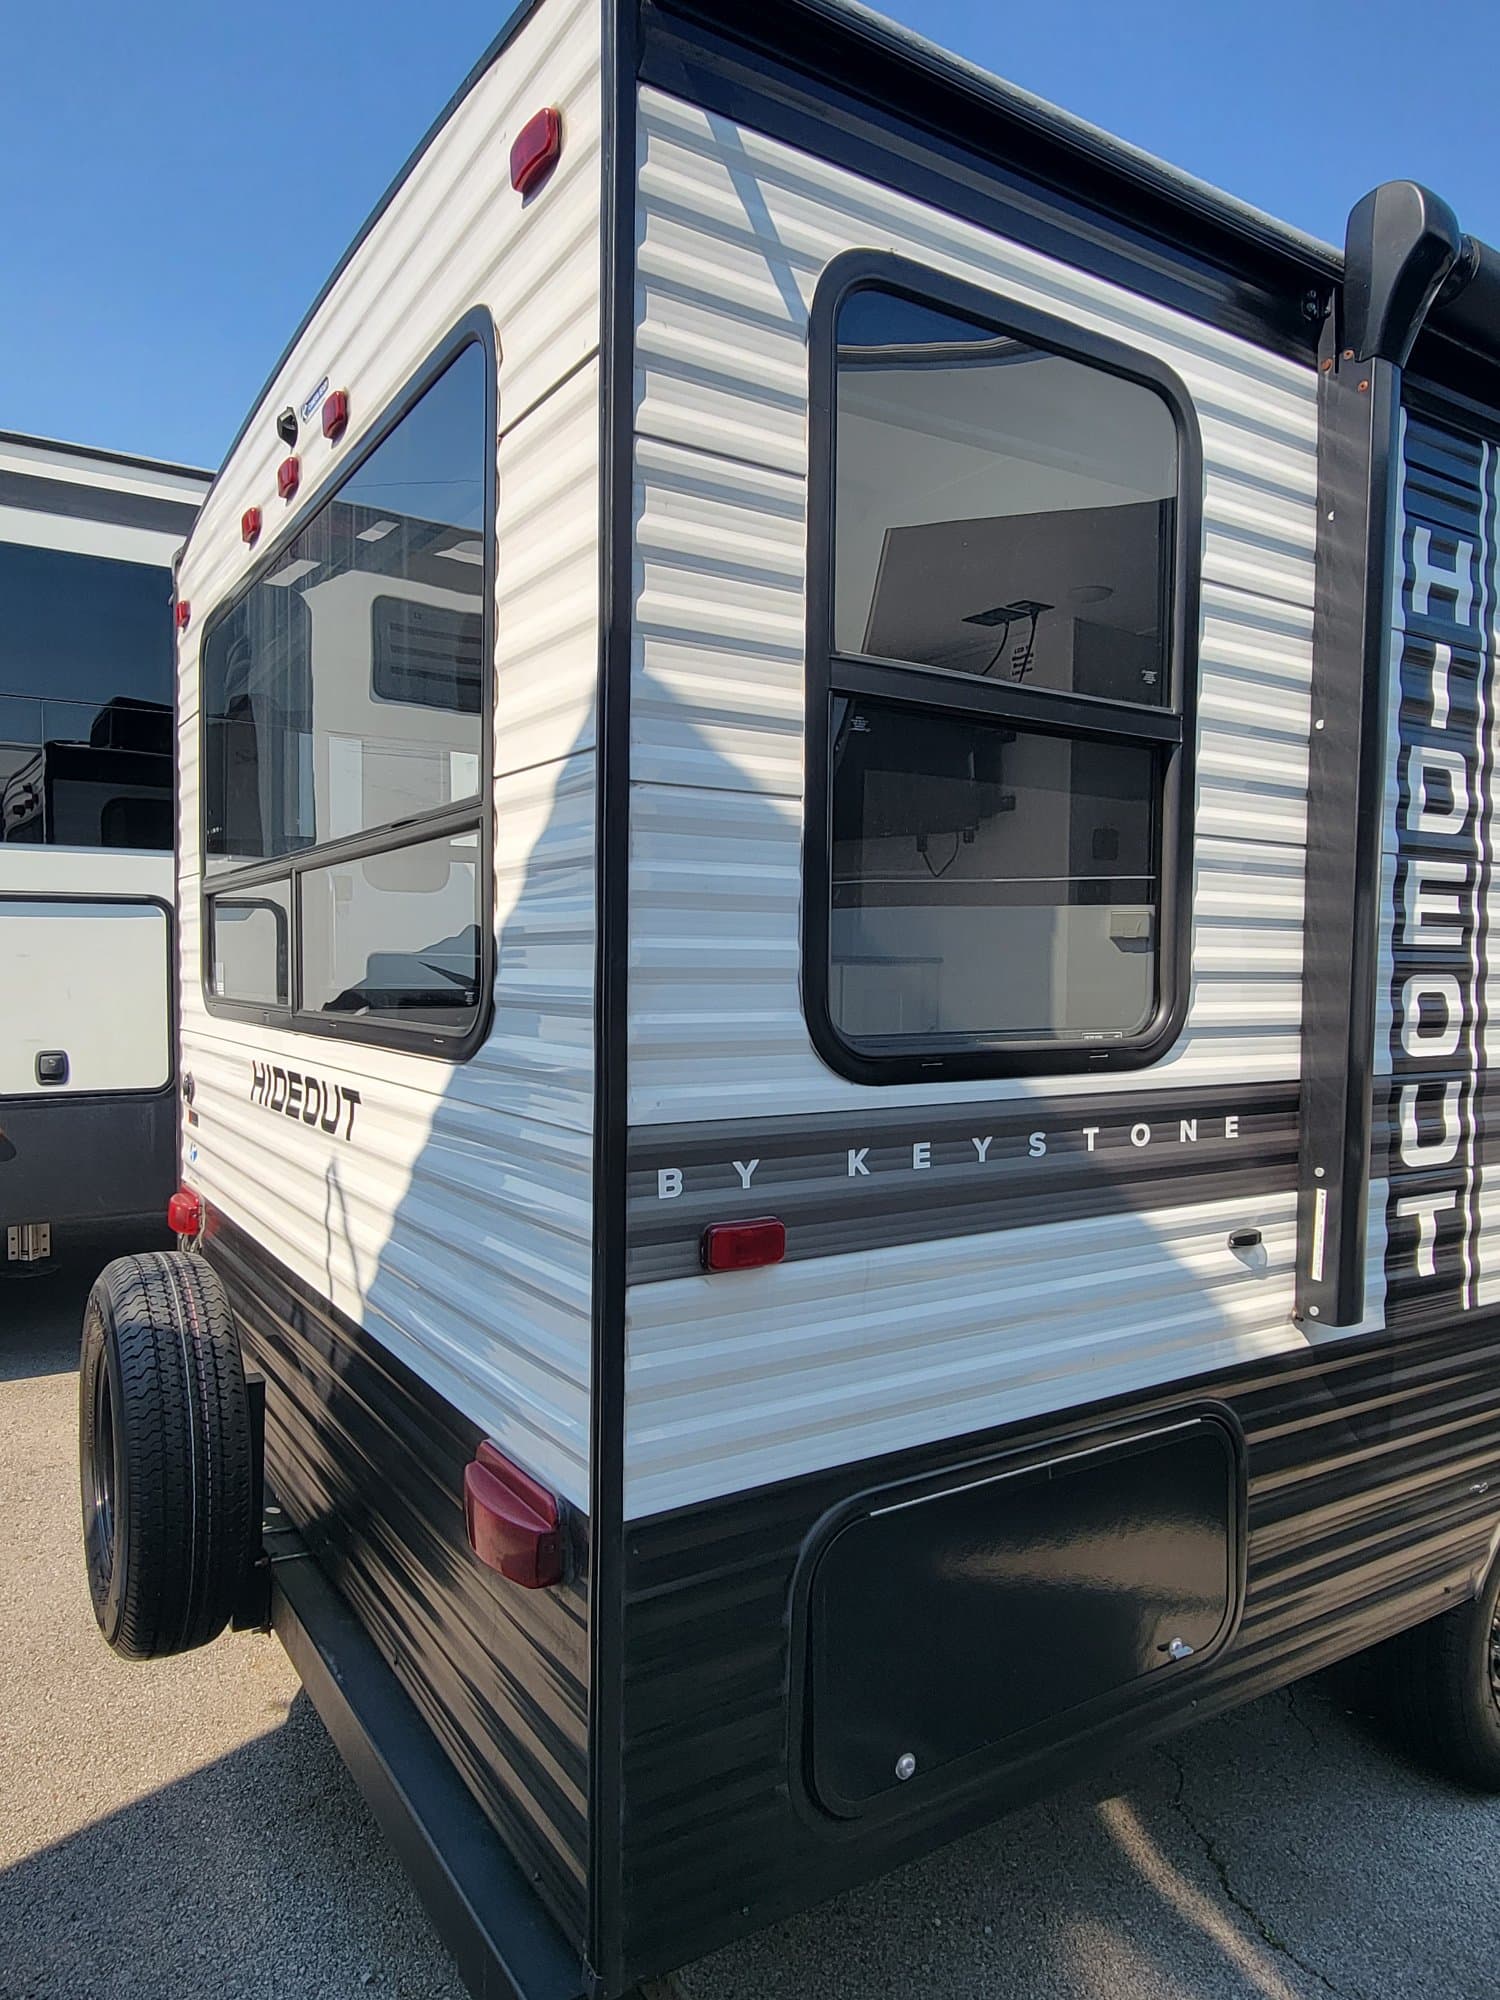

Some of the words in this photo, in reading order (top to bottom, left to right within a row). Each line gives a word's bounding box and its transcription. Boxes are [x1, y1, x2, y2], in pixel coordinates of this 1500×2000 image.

[1396, 525, 1473, 1277] HIDEOUT
[250, 1060, 362, 1141] HIDEOUT
[658, 1159, 760, 1200] BY
[847, 1115, 1241, 1177] KEYSTONE
